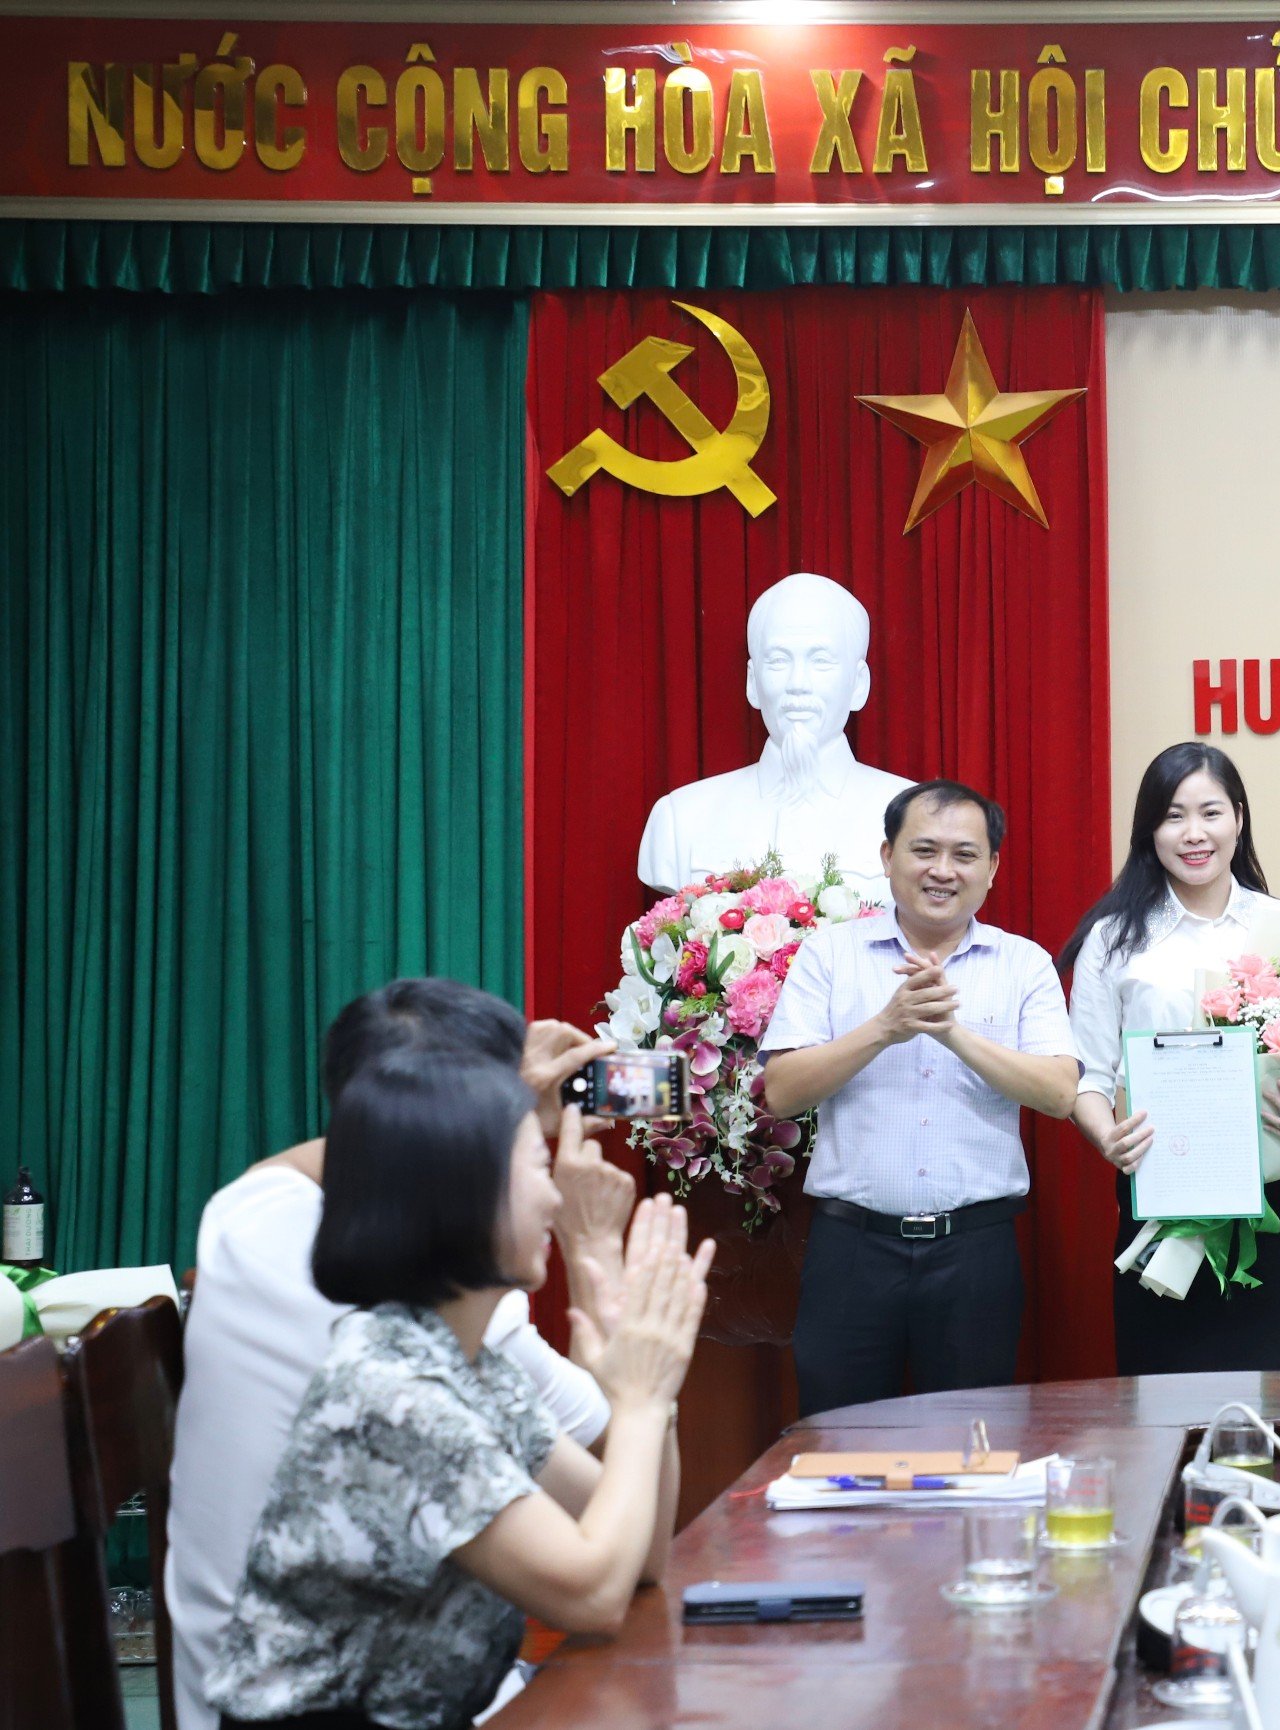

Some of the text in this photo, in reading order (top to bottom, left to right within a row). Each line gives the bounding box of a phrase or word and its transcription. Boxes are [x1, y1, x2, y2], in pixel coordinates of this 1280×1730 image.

[68, 32, 306, 171] NƯỚC
[337, 43, 569, 194] CỘNG
[604, 42, 777, 174] HÒA
[809, 44, 929, 174] XÃ
[970, 44, 1107, 195] HỘI
